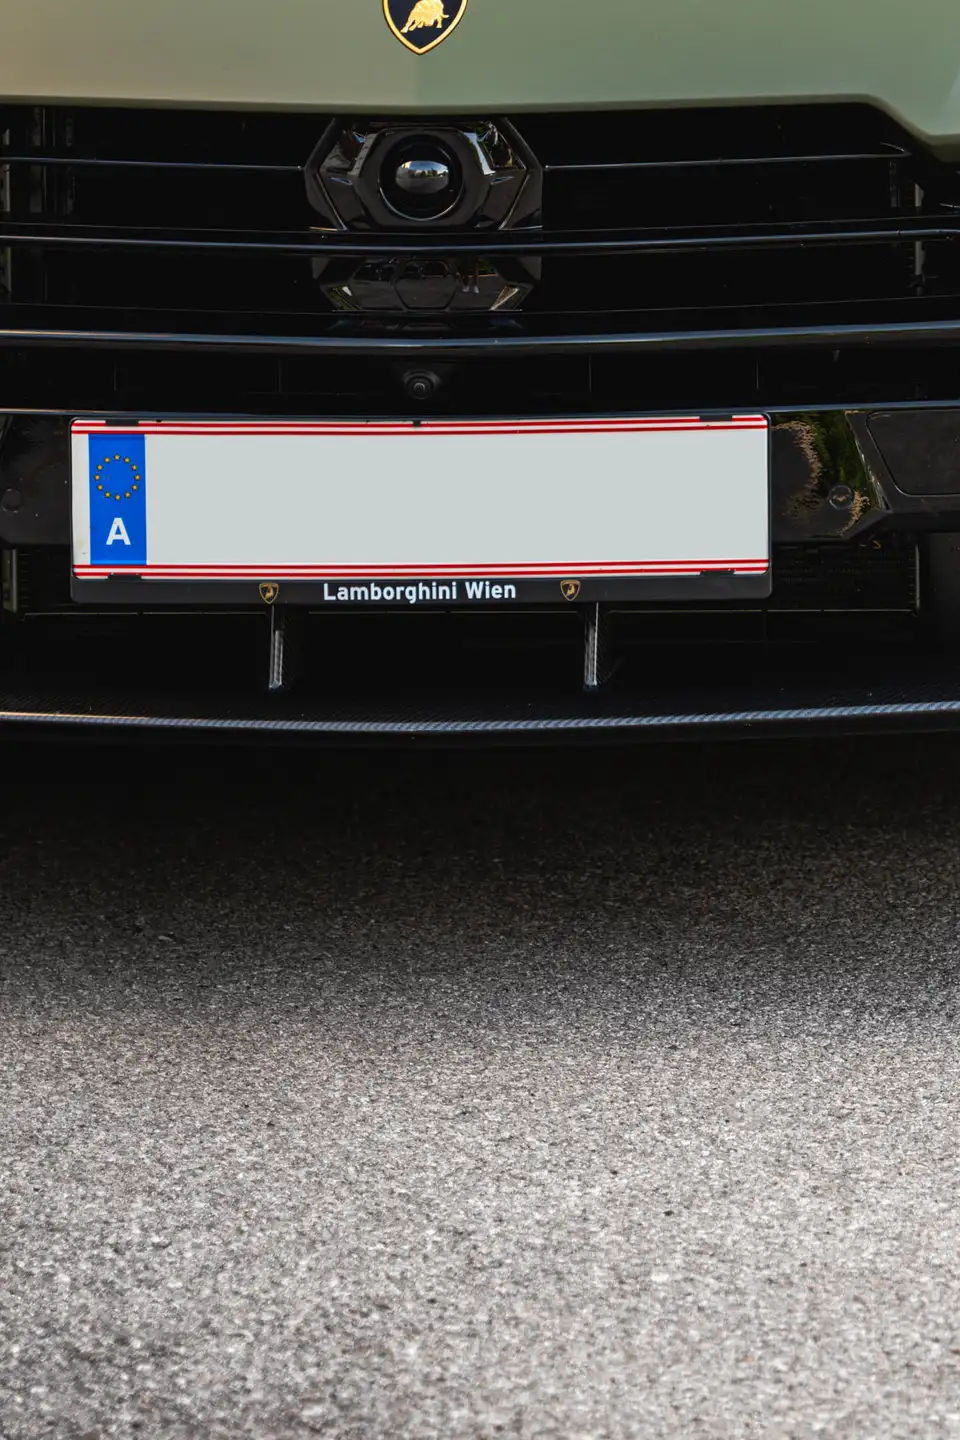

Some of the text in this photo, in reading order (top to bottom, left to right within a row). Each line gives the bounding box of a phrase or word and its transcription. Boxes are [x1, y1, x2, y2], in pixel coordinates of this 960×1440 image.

[105, 517, 132, 546] A
[323, 580, 517, 604] Lamborghini Wien
